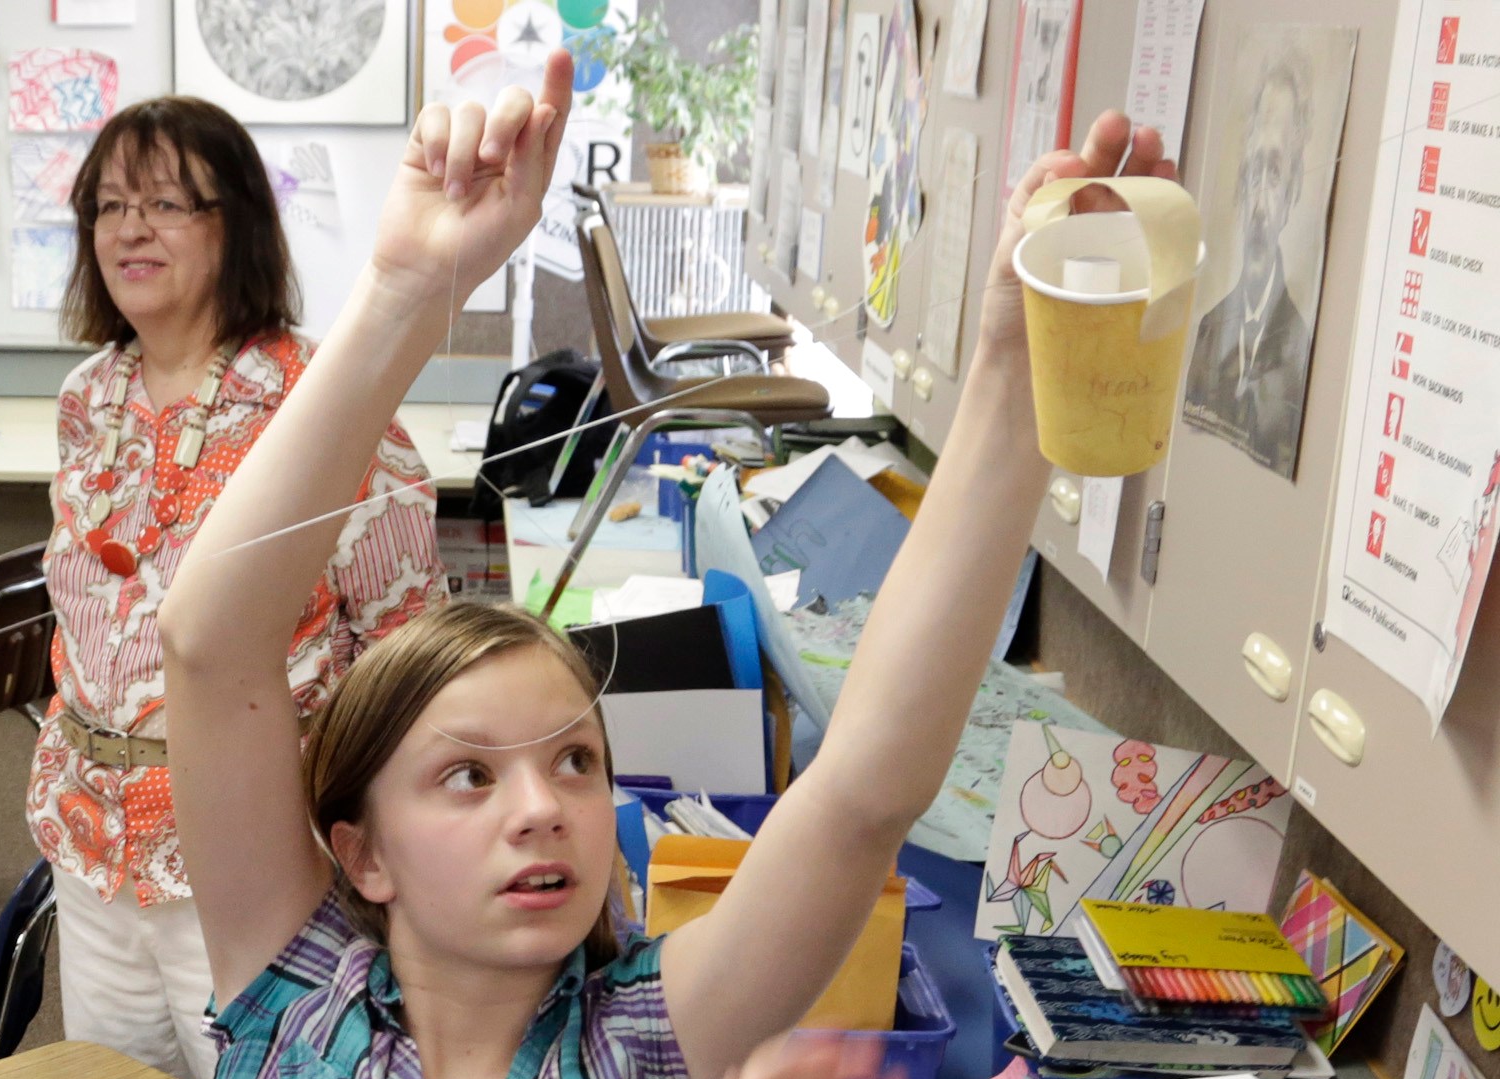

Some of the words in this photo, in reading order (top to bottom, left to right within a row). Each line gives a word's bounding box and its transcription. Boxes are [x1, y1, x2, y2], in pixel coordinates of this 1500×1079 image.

[587, 142, 621, 185] R
[1462, 256, 1484, 274] CHECK
[1428, 379, 1463, 405] BACKWARDS
[1413, 439, 1436, 461] LOGICAL
[1436, 450, 1473, 478] REASONING
[1414, 505, 1440, 531] SIMPLER
[1383, 552, 1419, 583] BRAINSTORM
[1349, 589, 1371, 618] Creative
[1371, 605, 1407, 643] Publications
